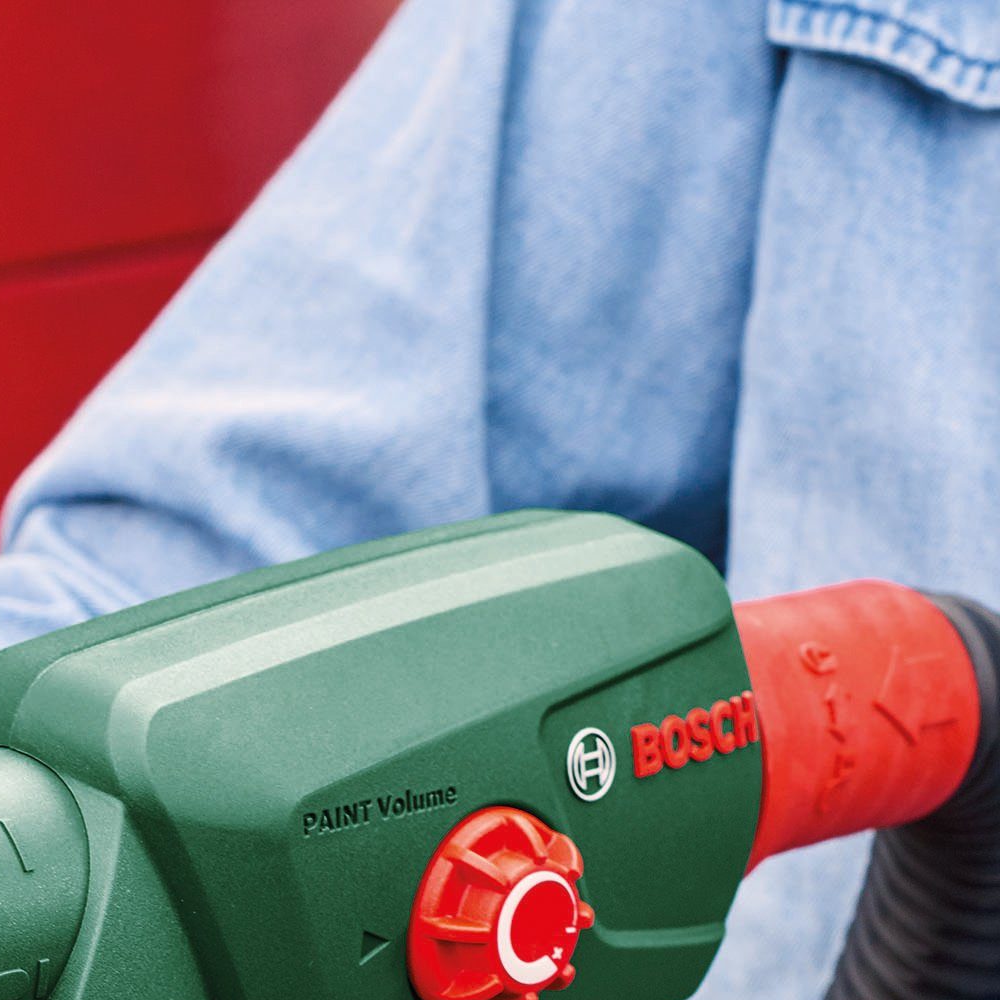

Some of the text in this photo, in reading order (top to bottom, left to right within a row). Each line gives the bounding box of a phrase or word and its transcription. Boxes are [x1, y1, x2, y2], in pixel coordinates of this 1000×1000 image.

[631, 690, 759, 778] BOSCH
[302, 785, 458, 837] PAINT Volume
